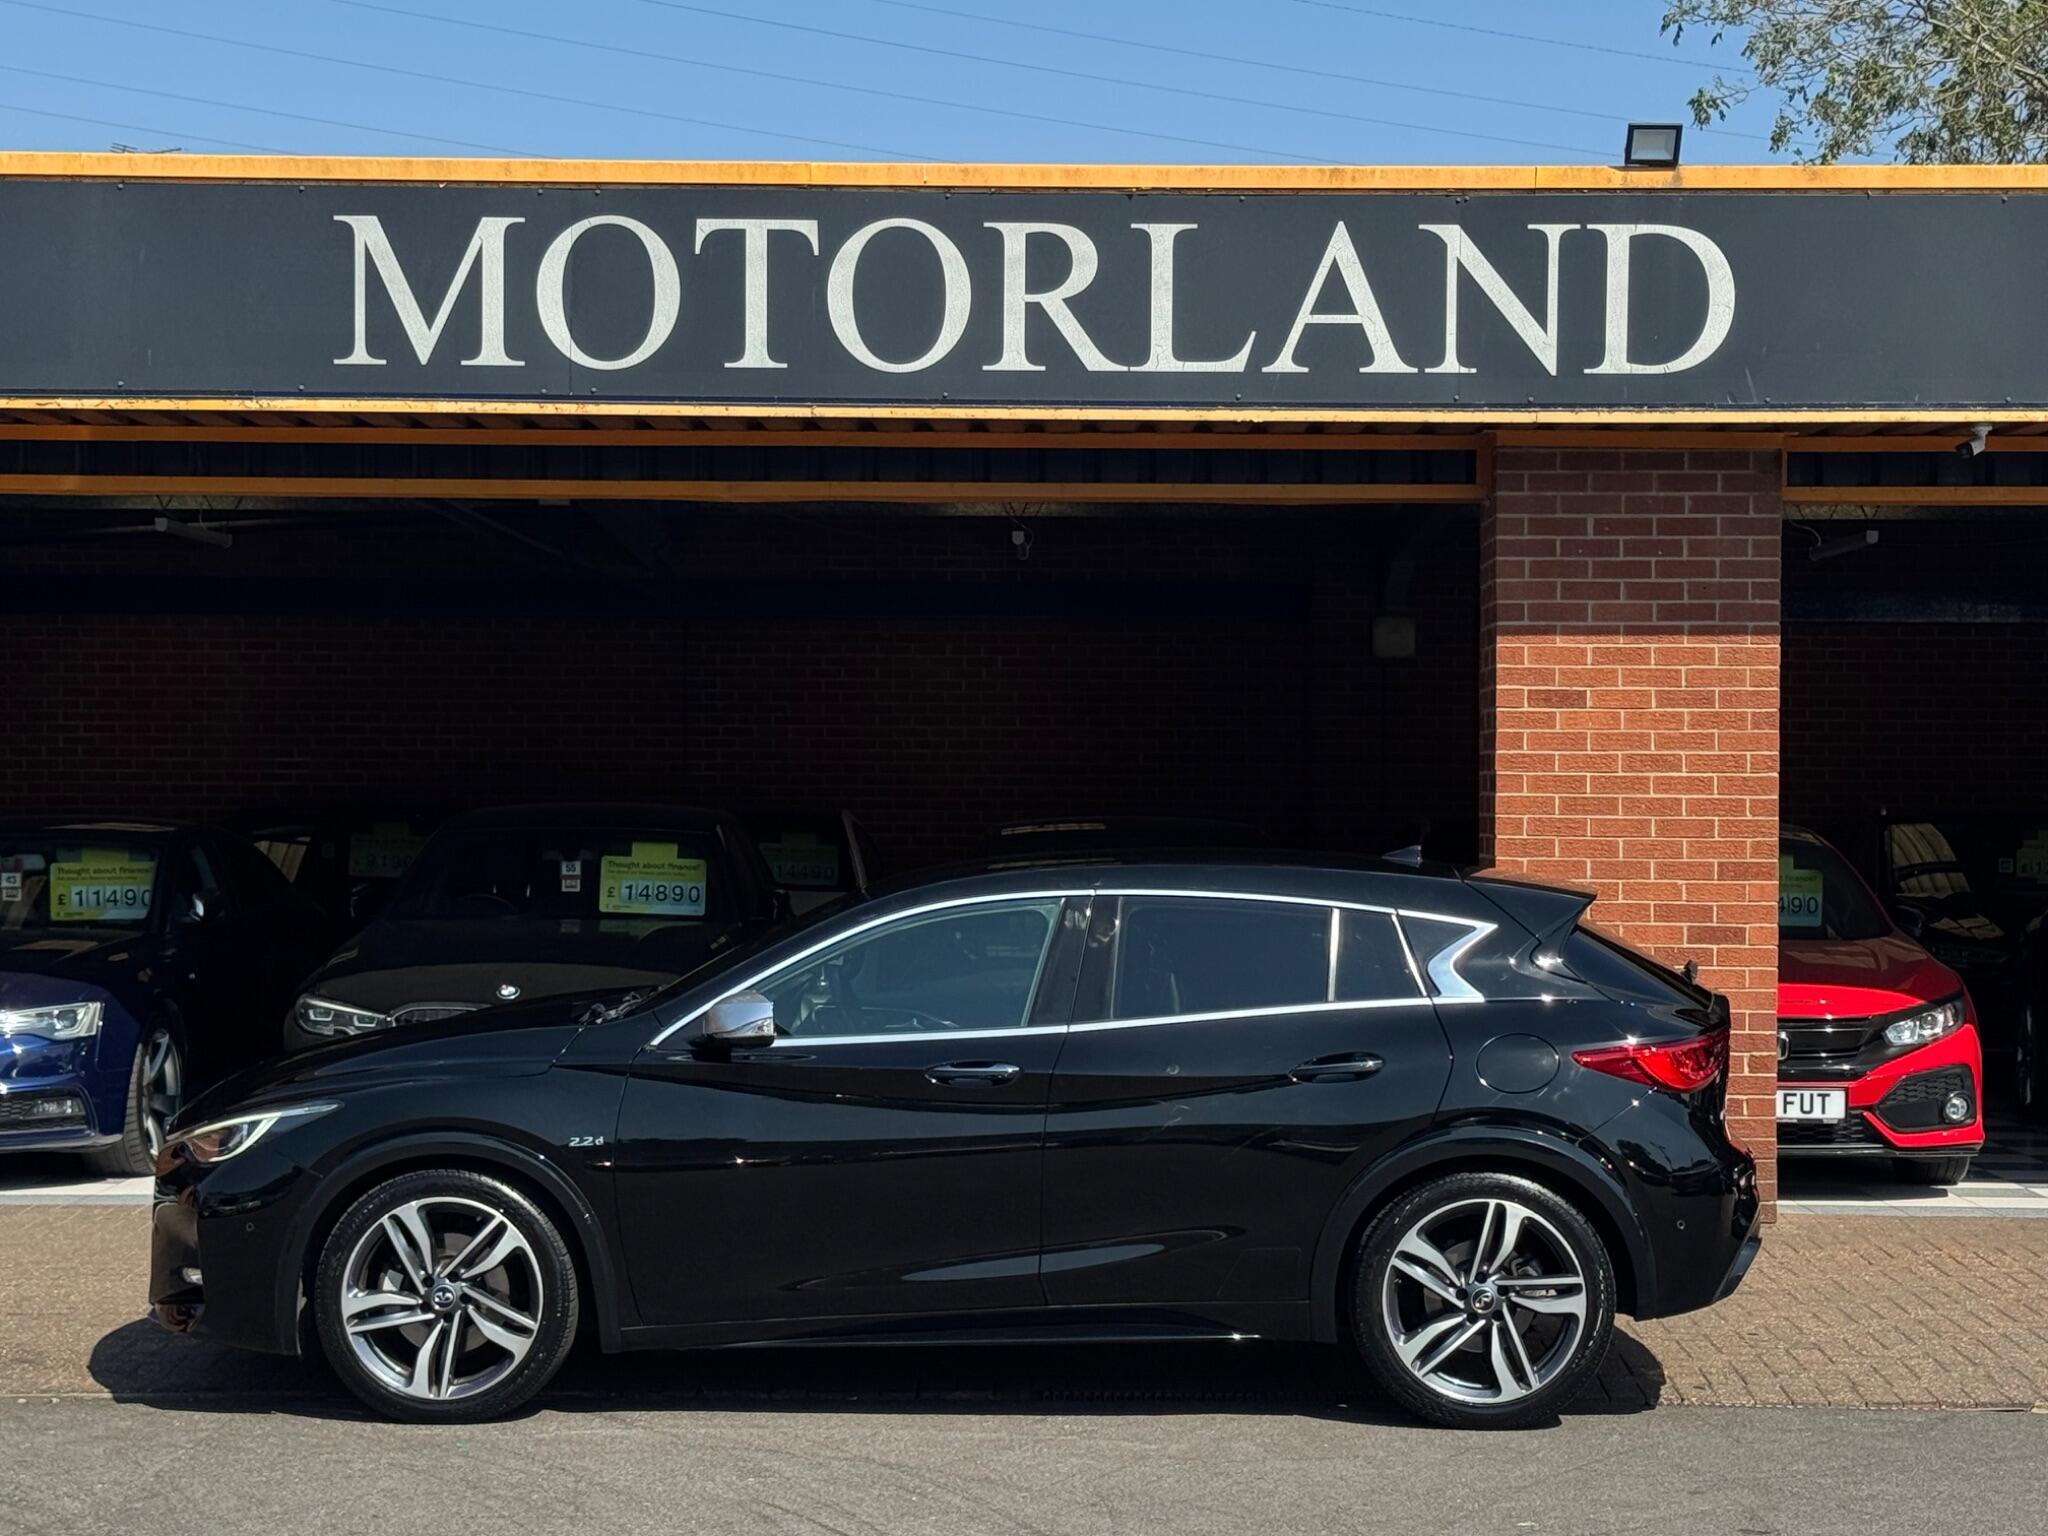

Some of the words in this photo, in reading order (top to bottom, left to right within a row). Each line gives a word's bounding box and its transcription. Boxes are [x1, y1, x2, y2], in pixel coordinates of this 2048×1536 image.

[333, 215, 1736, 376] MOTORLAND
[624, 884, 701, 903] 14890
[1783, 1093, 1831, 1115] FUT
